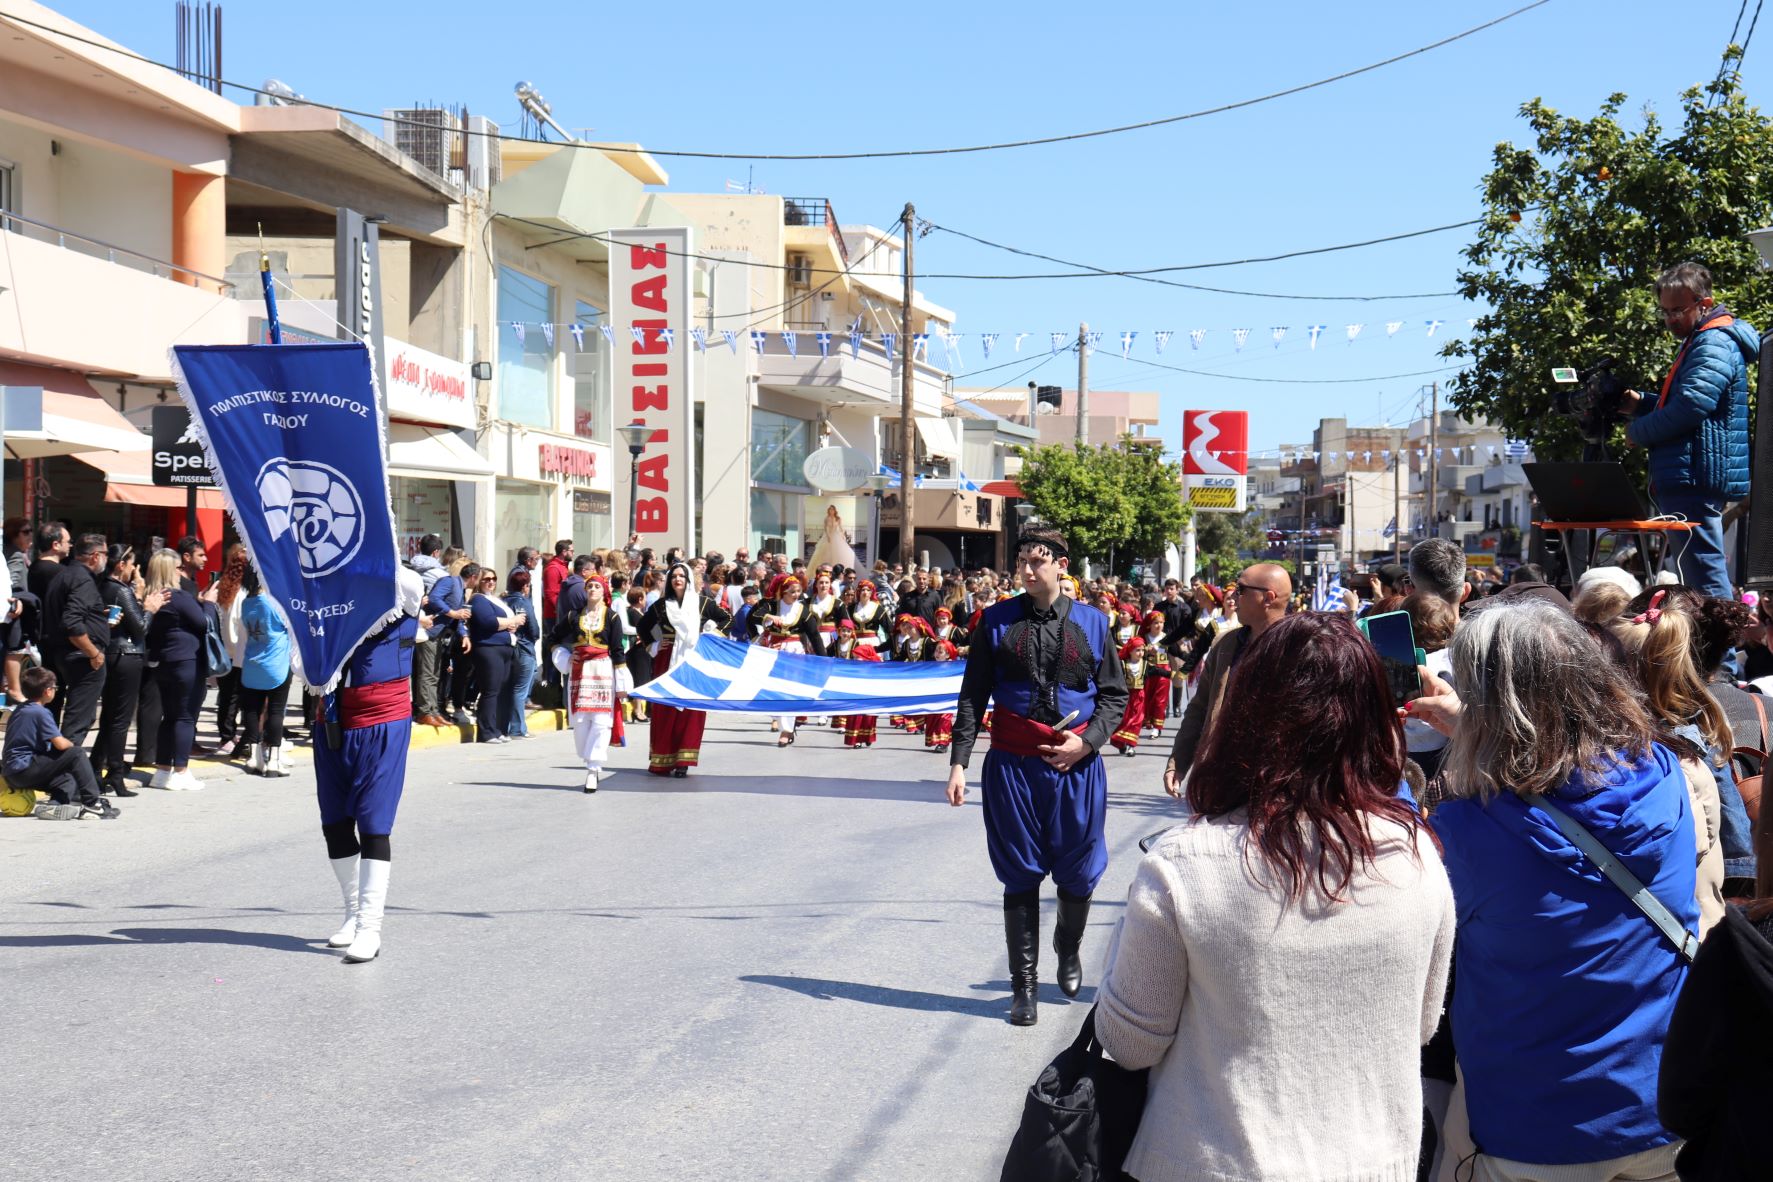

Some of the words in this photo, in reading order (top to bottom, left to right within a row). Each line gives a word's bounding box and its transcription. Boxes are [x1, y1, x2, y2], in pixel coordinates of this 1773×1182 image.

[292, 391, 370, 418] ΣΥΛΛΟΓΟΣ
[263, 413, 309, 430] ΓΑΖΙΟΥ
[170, 475, 213, 484] PATISSERIE
[1204, 478, 1235, 487] EKO
